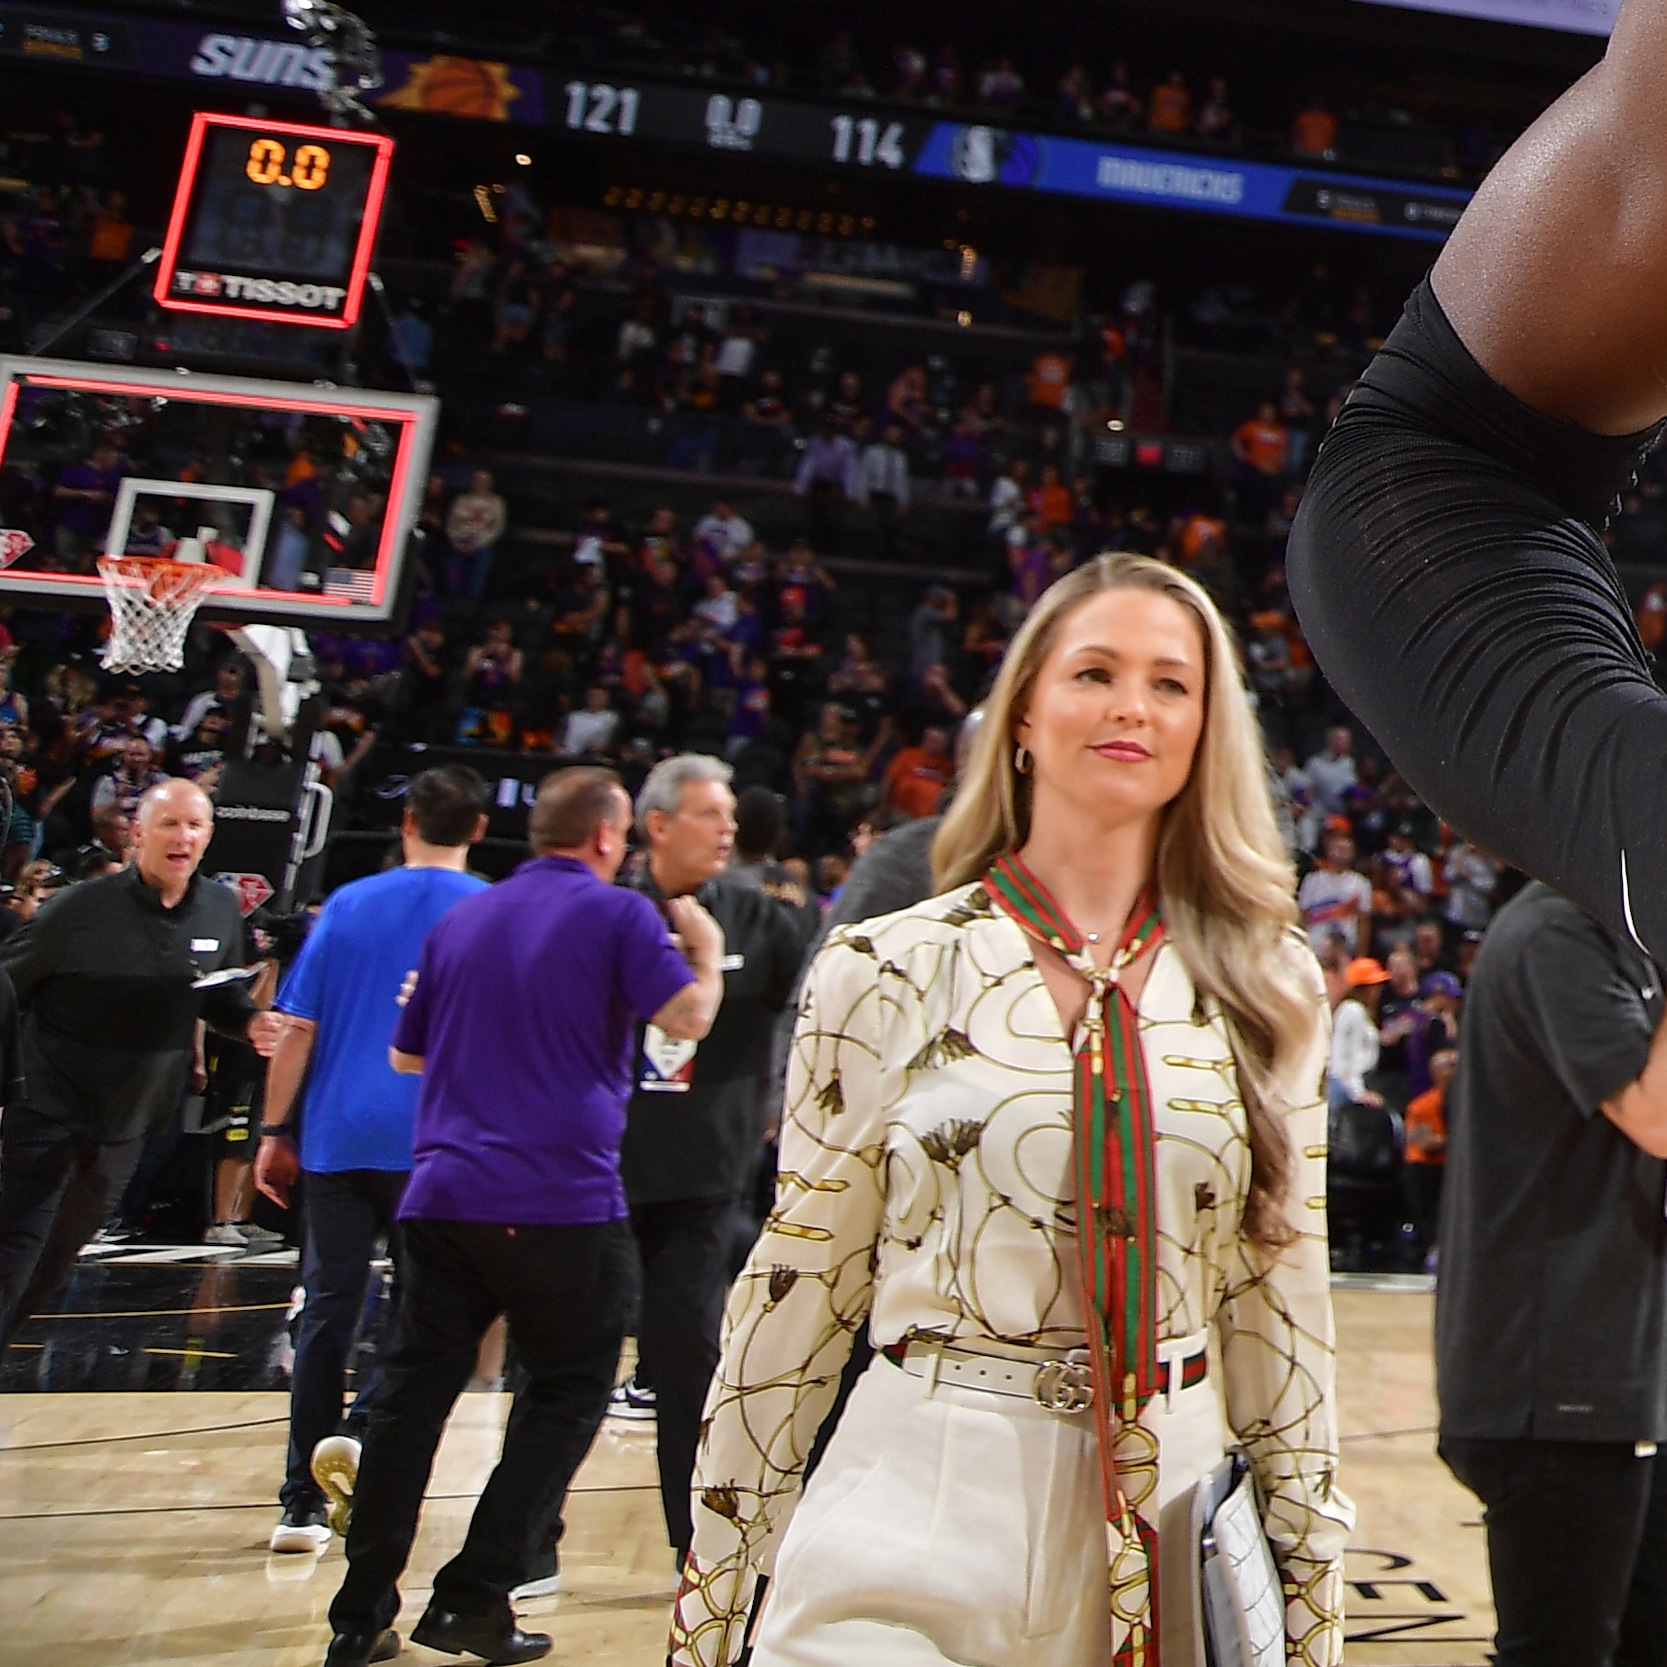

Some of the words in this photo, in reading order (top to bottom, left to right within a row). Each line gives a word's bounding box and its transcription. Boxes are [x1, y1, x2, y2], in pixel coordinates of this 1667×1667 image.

[563, 79, 640, 135] 121
[246, 138, 332, 191] 0.0
[831, 114, 905, 169] 114
[224, 274, 347, 311] TISSOT
